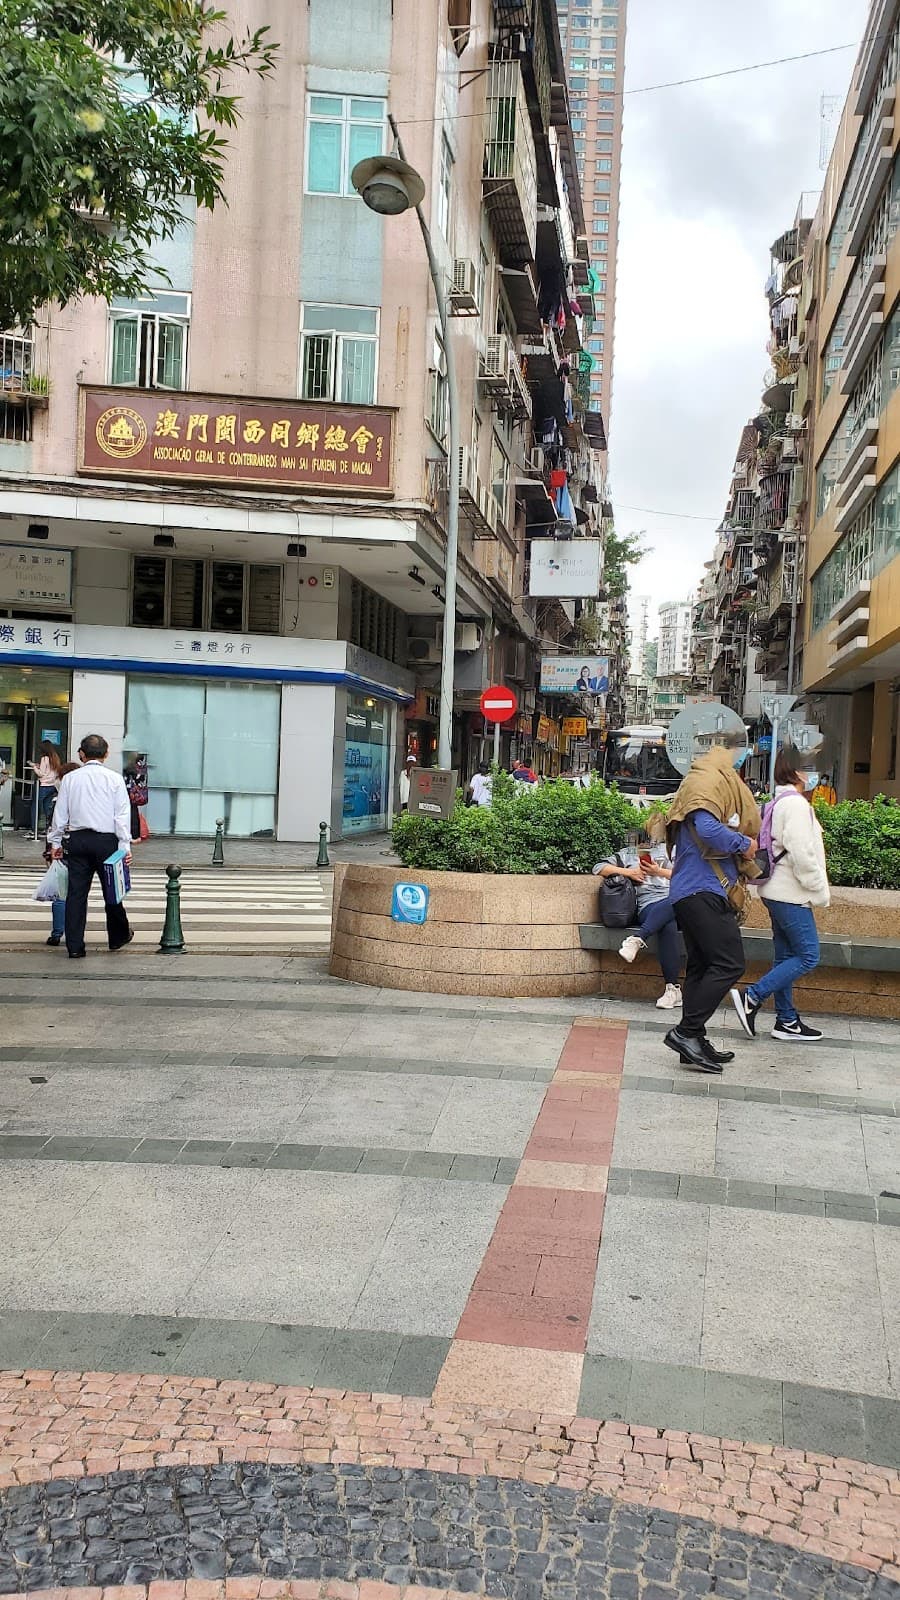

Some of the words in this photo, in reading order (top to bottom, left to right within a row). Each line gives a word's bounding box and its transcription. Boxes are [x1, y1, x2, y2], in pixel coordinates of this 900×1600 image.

[154, 408, 374, 454] 澳門閩西同鄉總會
[153, 446, 192, 463] ASSOCIAÇÃO
[195, 449, 214, 464] GERAL
[217, 451, 225, 464] DE
[281, 456, 296, 470] MAN
[299, 457, 308, 471] SAI
[312, 458, 336, 475] (FUKIEN)
[340, 460, 348, 473] DE
[352, 461, 373, 476] MACAU
[0, 623, 72, 647] 際銀行
